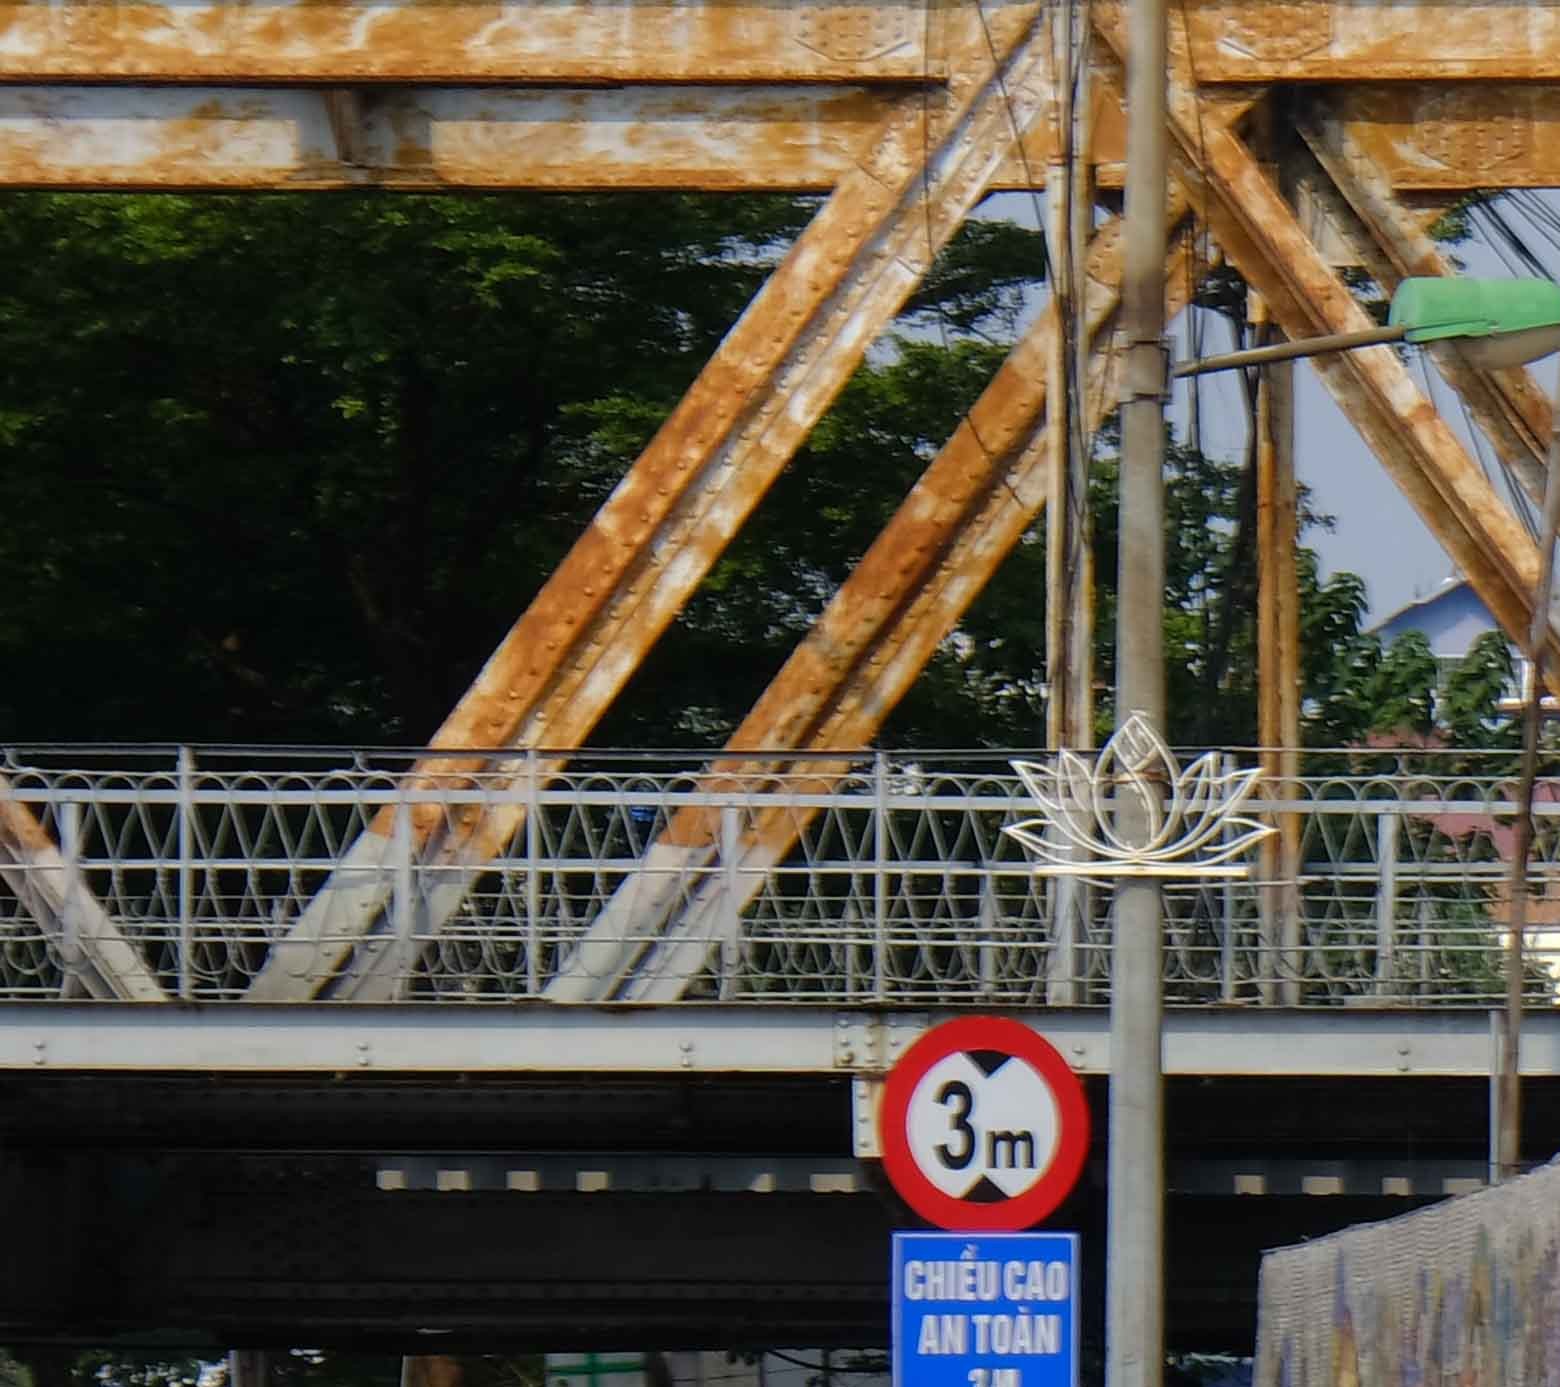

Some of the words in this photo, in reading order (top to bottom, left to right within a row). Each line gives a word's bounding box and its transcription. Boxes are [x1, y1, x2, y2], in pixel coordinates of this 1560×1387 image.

[1003, 1260, 1069, 1301] CAO
[917, 1314, 967, 1355] AN
[971, 1306, 1061, 1355] TOÀN
